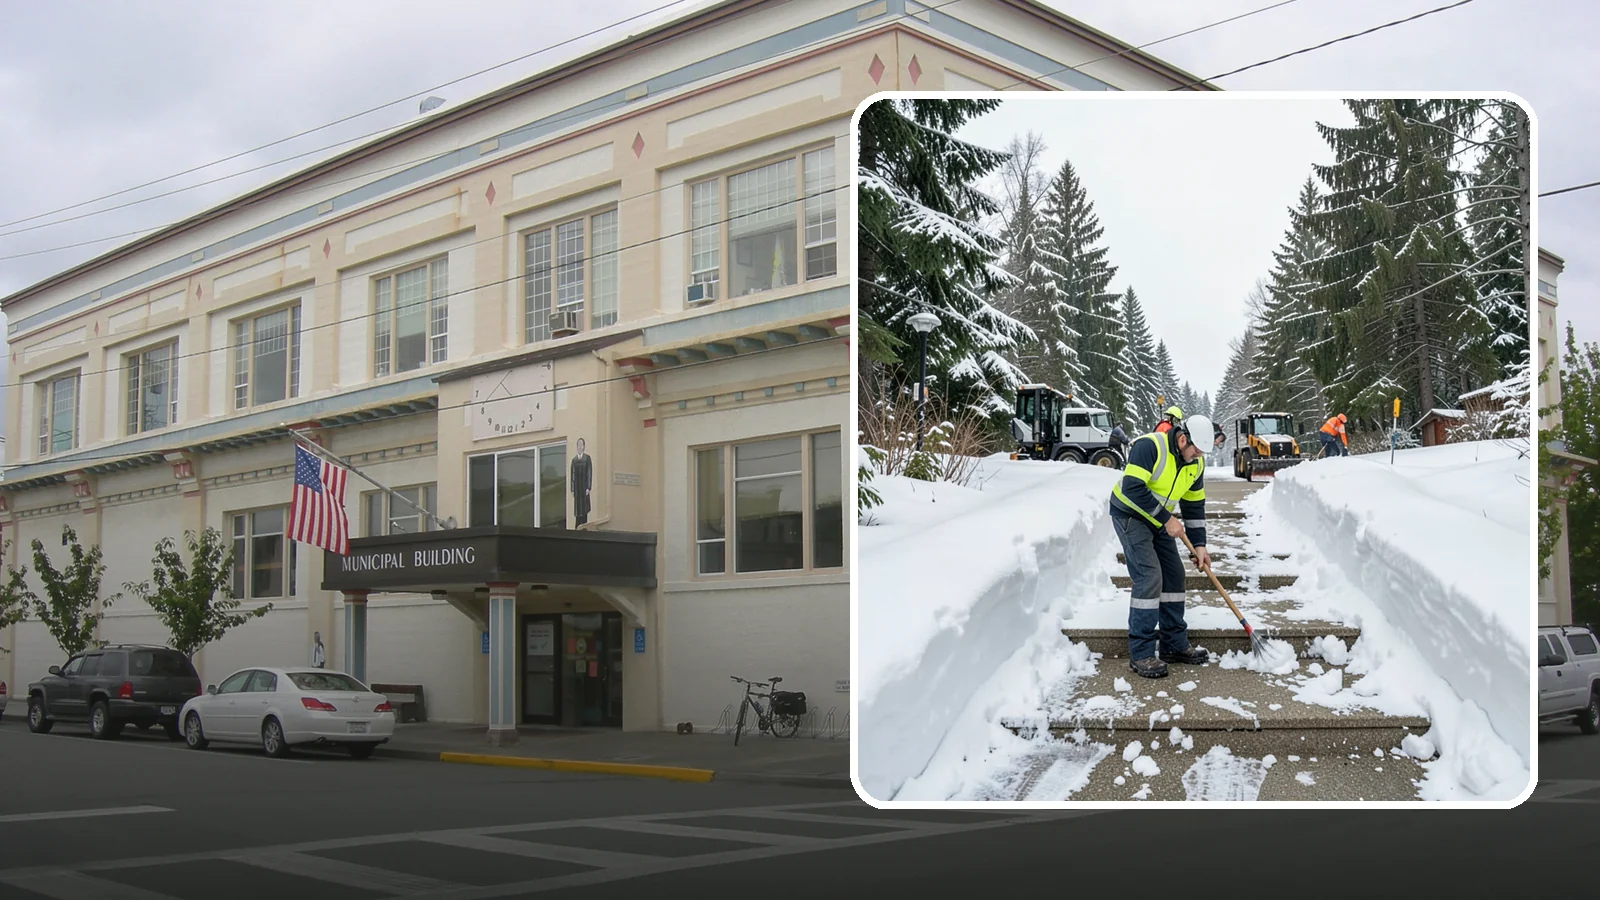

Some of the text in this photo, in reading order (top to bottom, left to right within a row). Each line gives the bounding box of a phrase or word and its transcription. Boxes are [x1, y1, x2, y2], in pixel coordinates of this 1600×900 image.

[547, 362, 552, 370] 6
[342, 546, 475, 572] MUNICIPAL BUILDING
